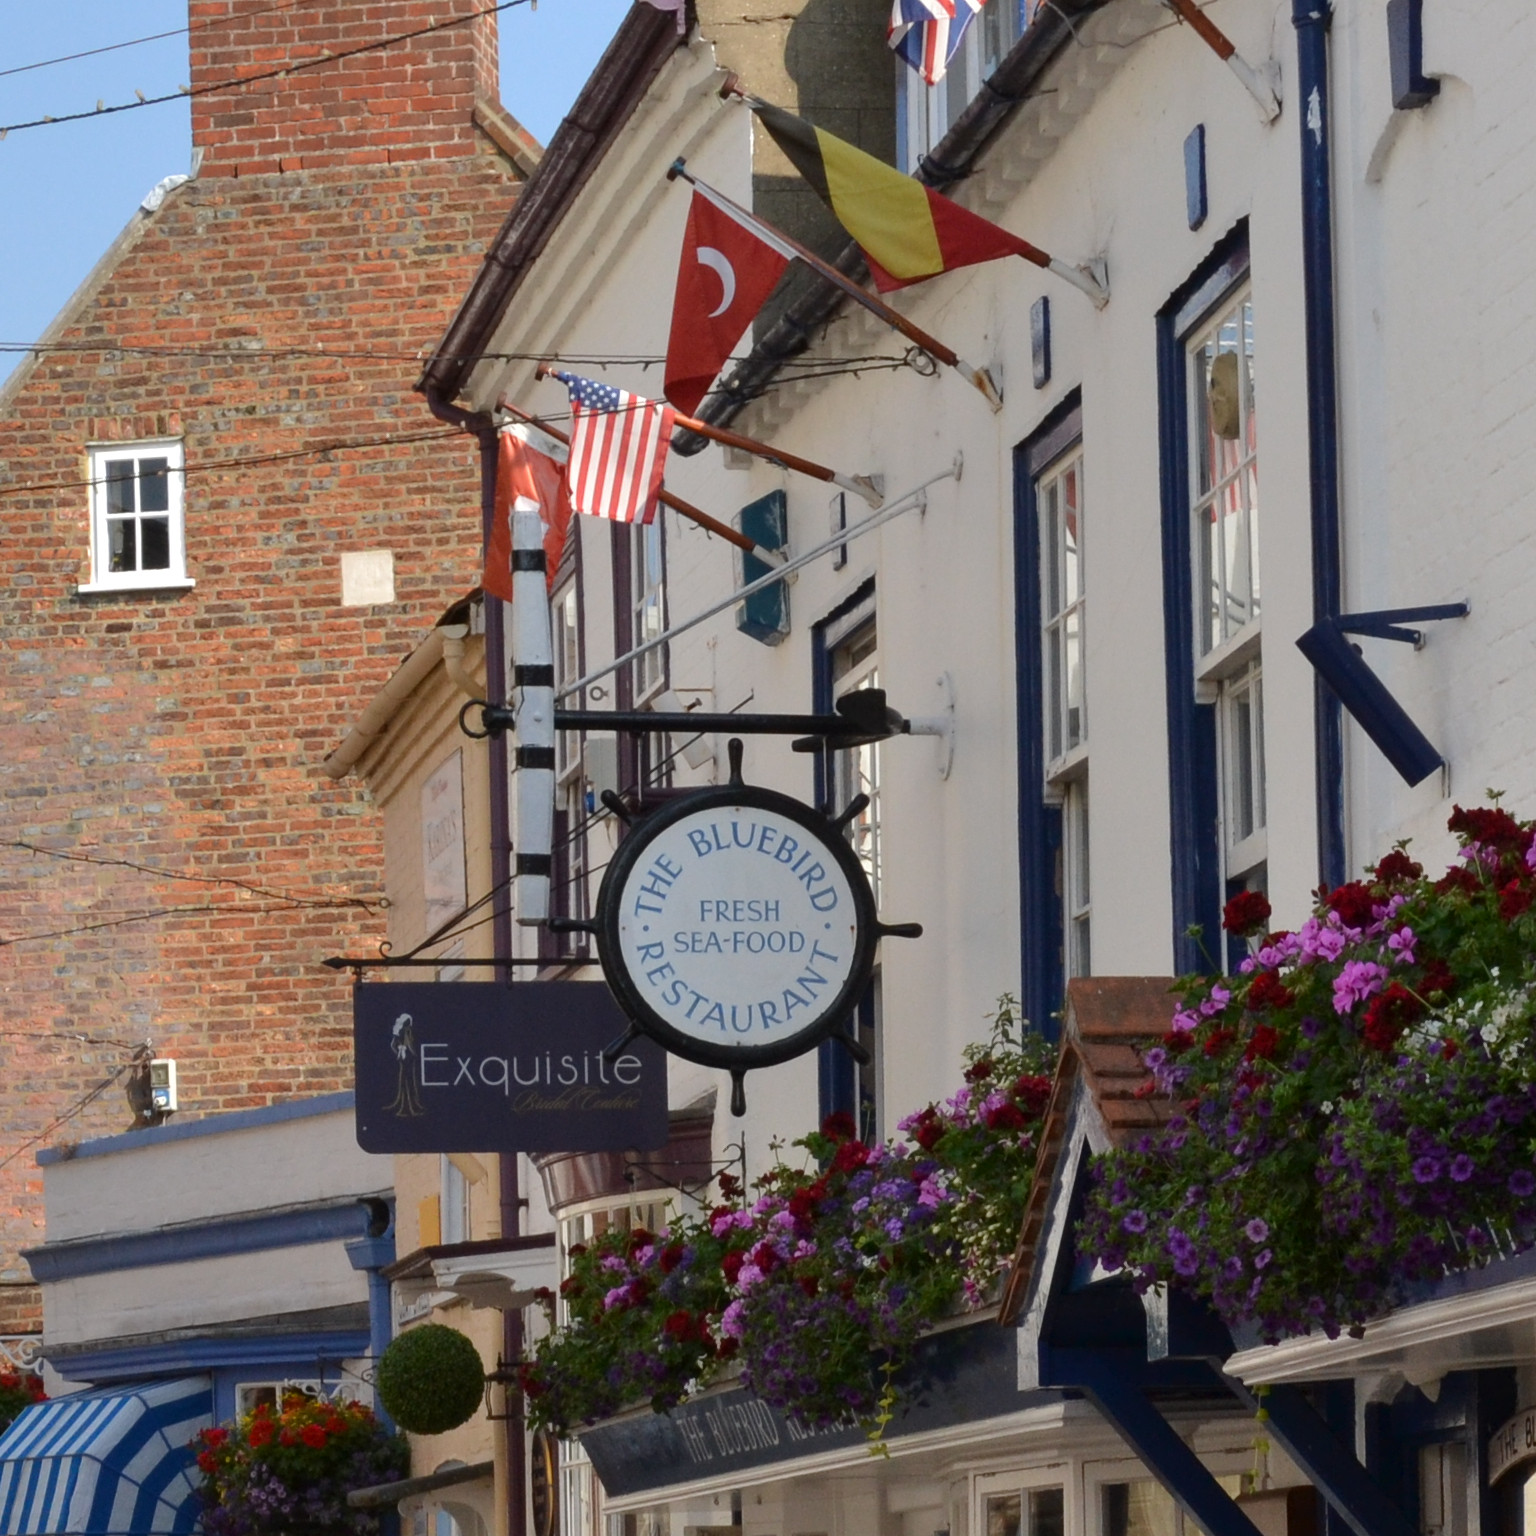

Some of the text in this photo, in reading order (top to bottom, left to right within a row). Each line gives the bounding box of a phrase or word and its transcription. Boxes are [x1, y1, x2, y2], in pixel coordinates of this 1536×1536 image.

[634, 821, 839, 918] THE BLUEBIRD
[700, 900, 781, 922] FRESH
[674, 931, 806, 953] SEA-FOOD
[636, 939, 839, 1033] RESTAURANT
[419, 1043, 643, 1095] Exquisite
[676, 1415, 713, 1464] THE
[706, 1399, 780, 1457] BLUEBIRD
[1497, 1423, 1518, 1465] THE
